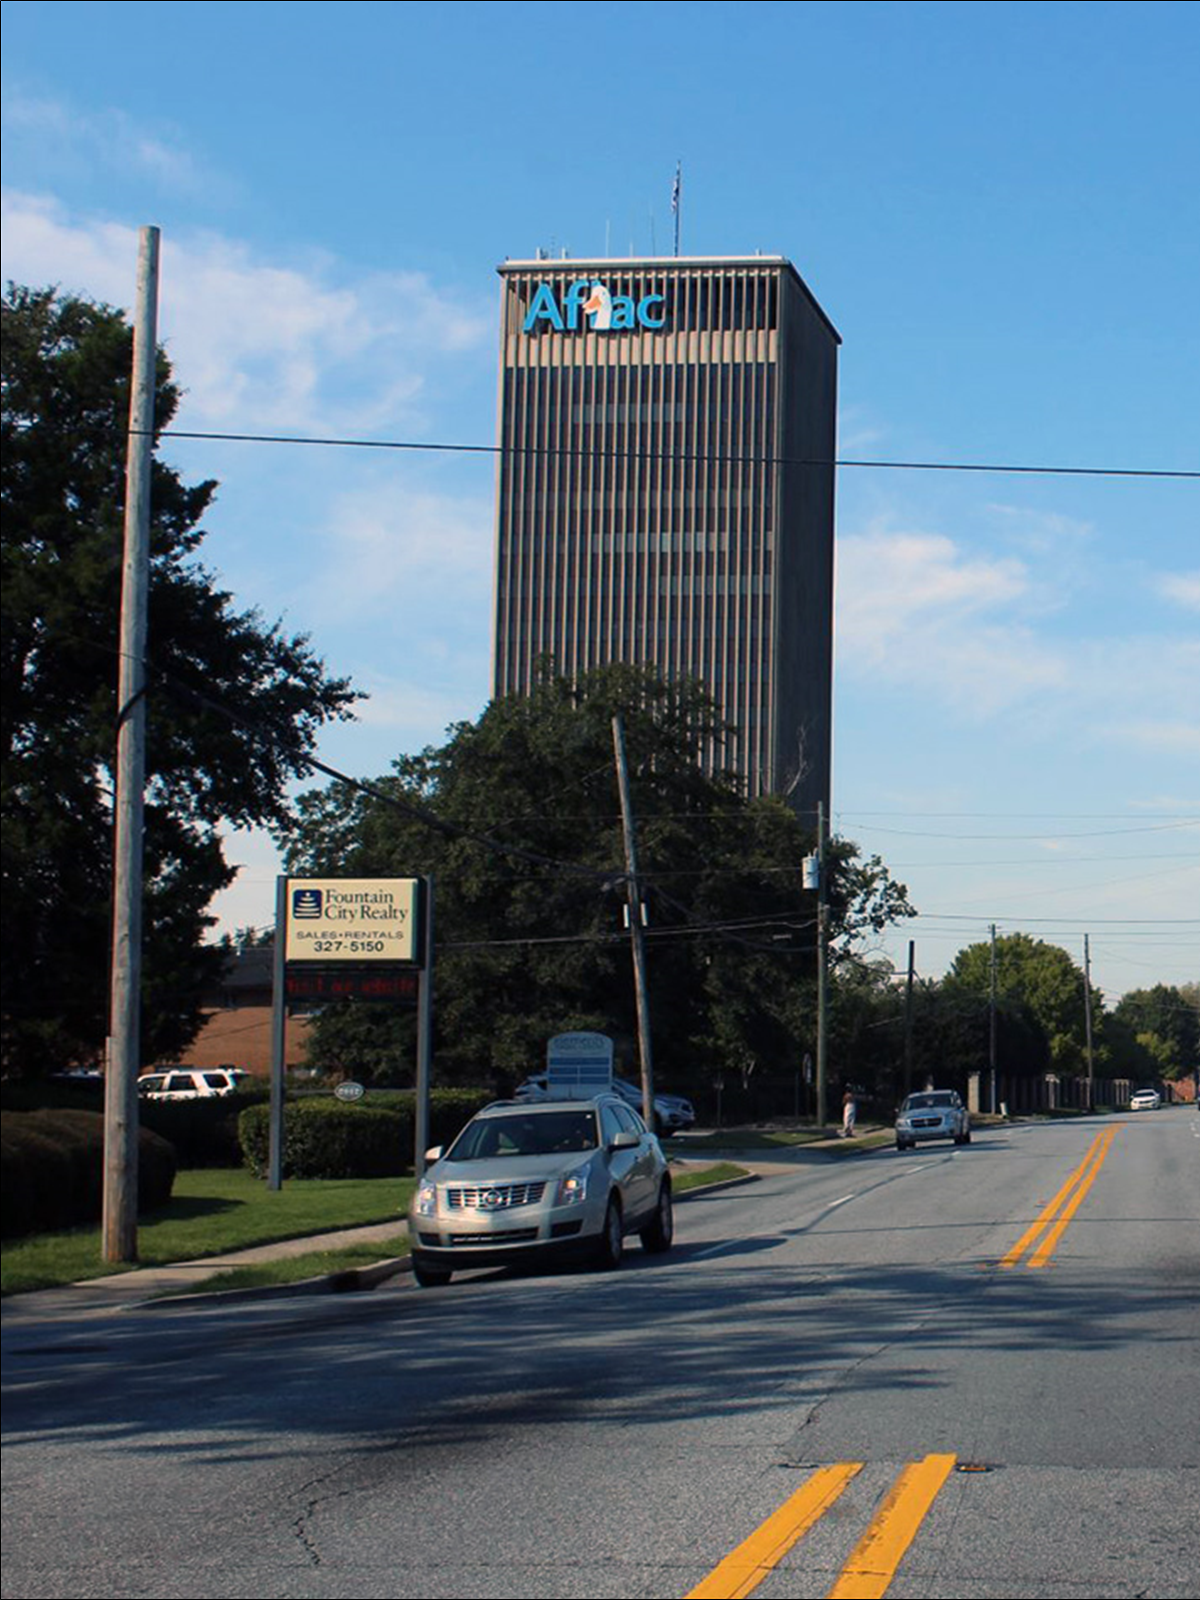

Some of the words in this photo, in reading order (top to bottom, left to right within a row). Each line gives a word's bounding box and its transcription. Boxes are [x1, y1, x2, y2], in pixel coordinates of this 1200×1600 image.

[326, 889, 394, 904] Fountain
[325, 905, 358, 923] City
[360, 905, 409, 923] Realty
[314, 941, 385, 952] 327-5150
